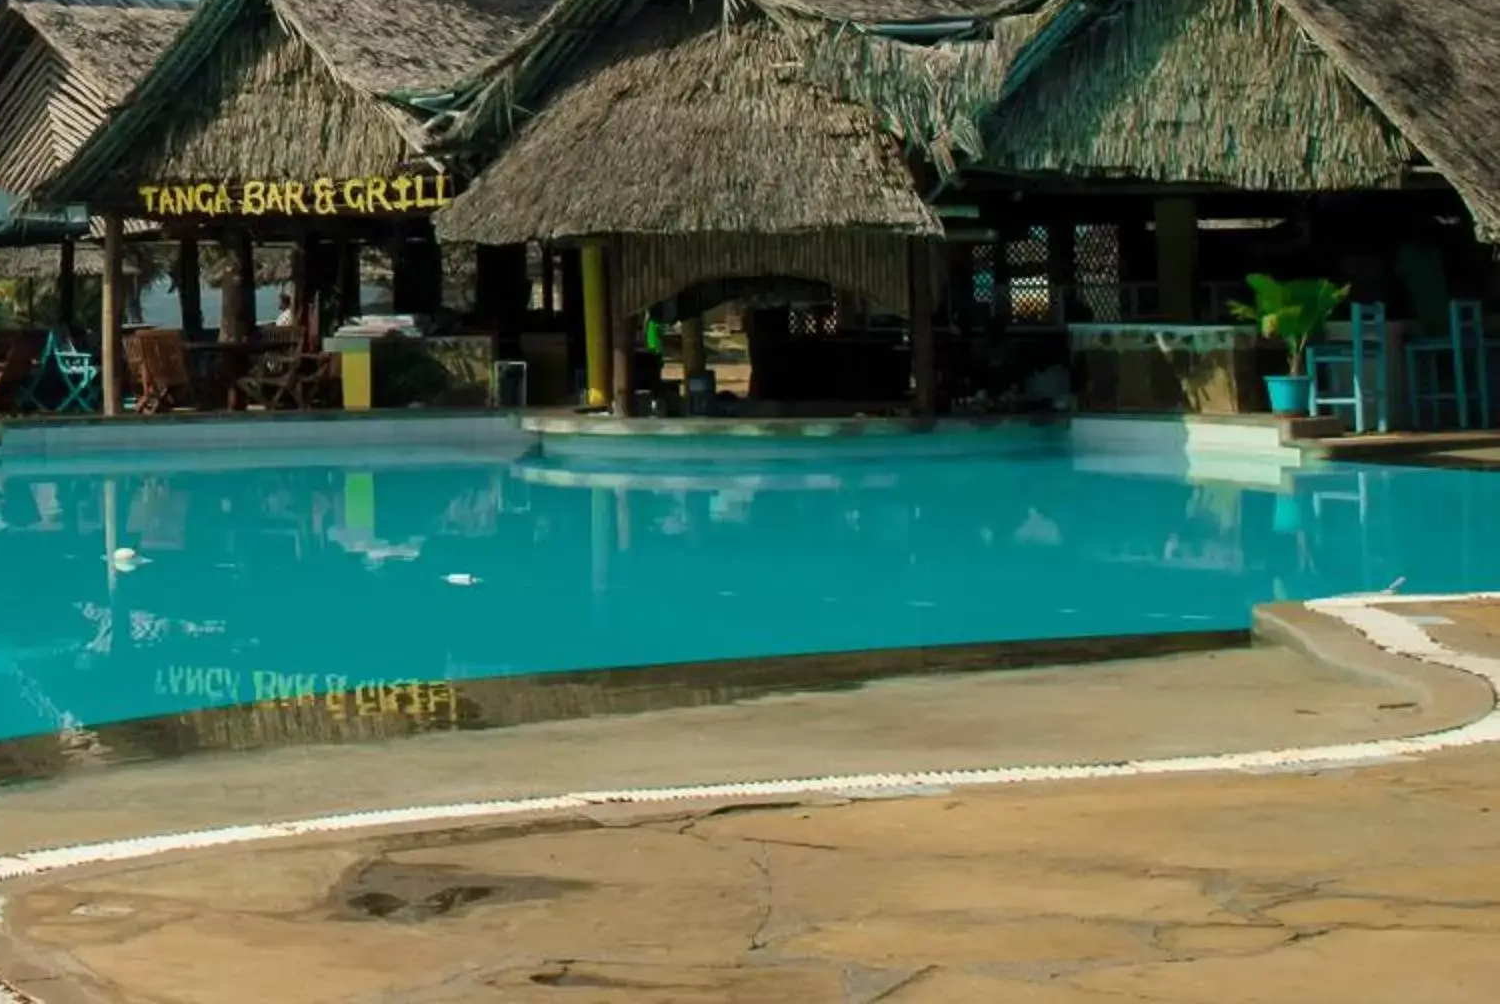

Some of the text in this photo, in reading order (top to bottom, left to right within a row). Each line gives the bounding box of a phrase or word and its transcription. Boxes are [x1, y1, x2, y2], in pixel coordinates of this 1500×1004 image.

[139, 175, 452, 216] TANGA BAR & GRILL
